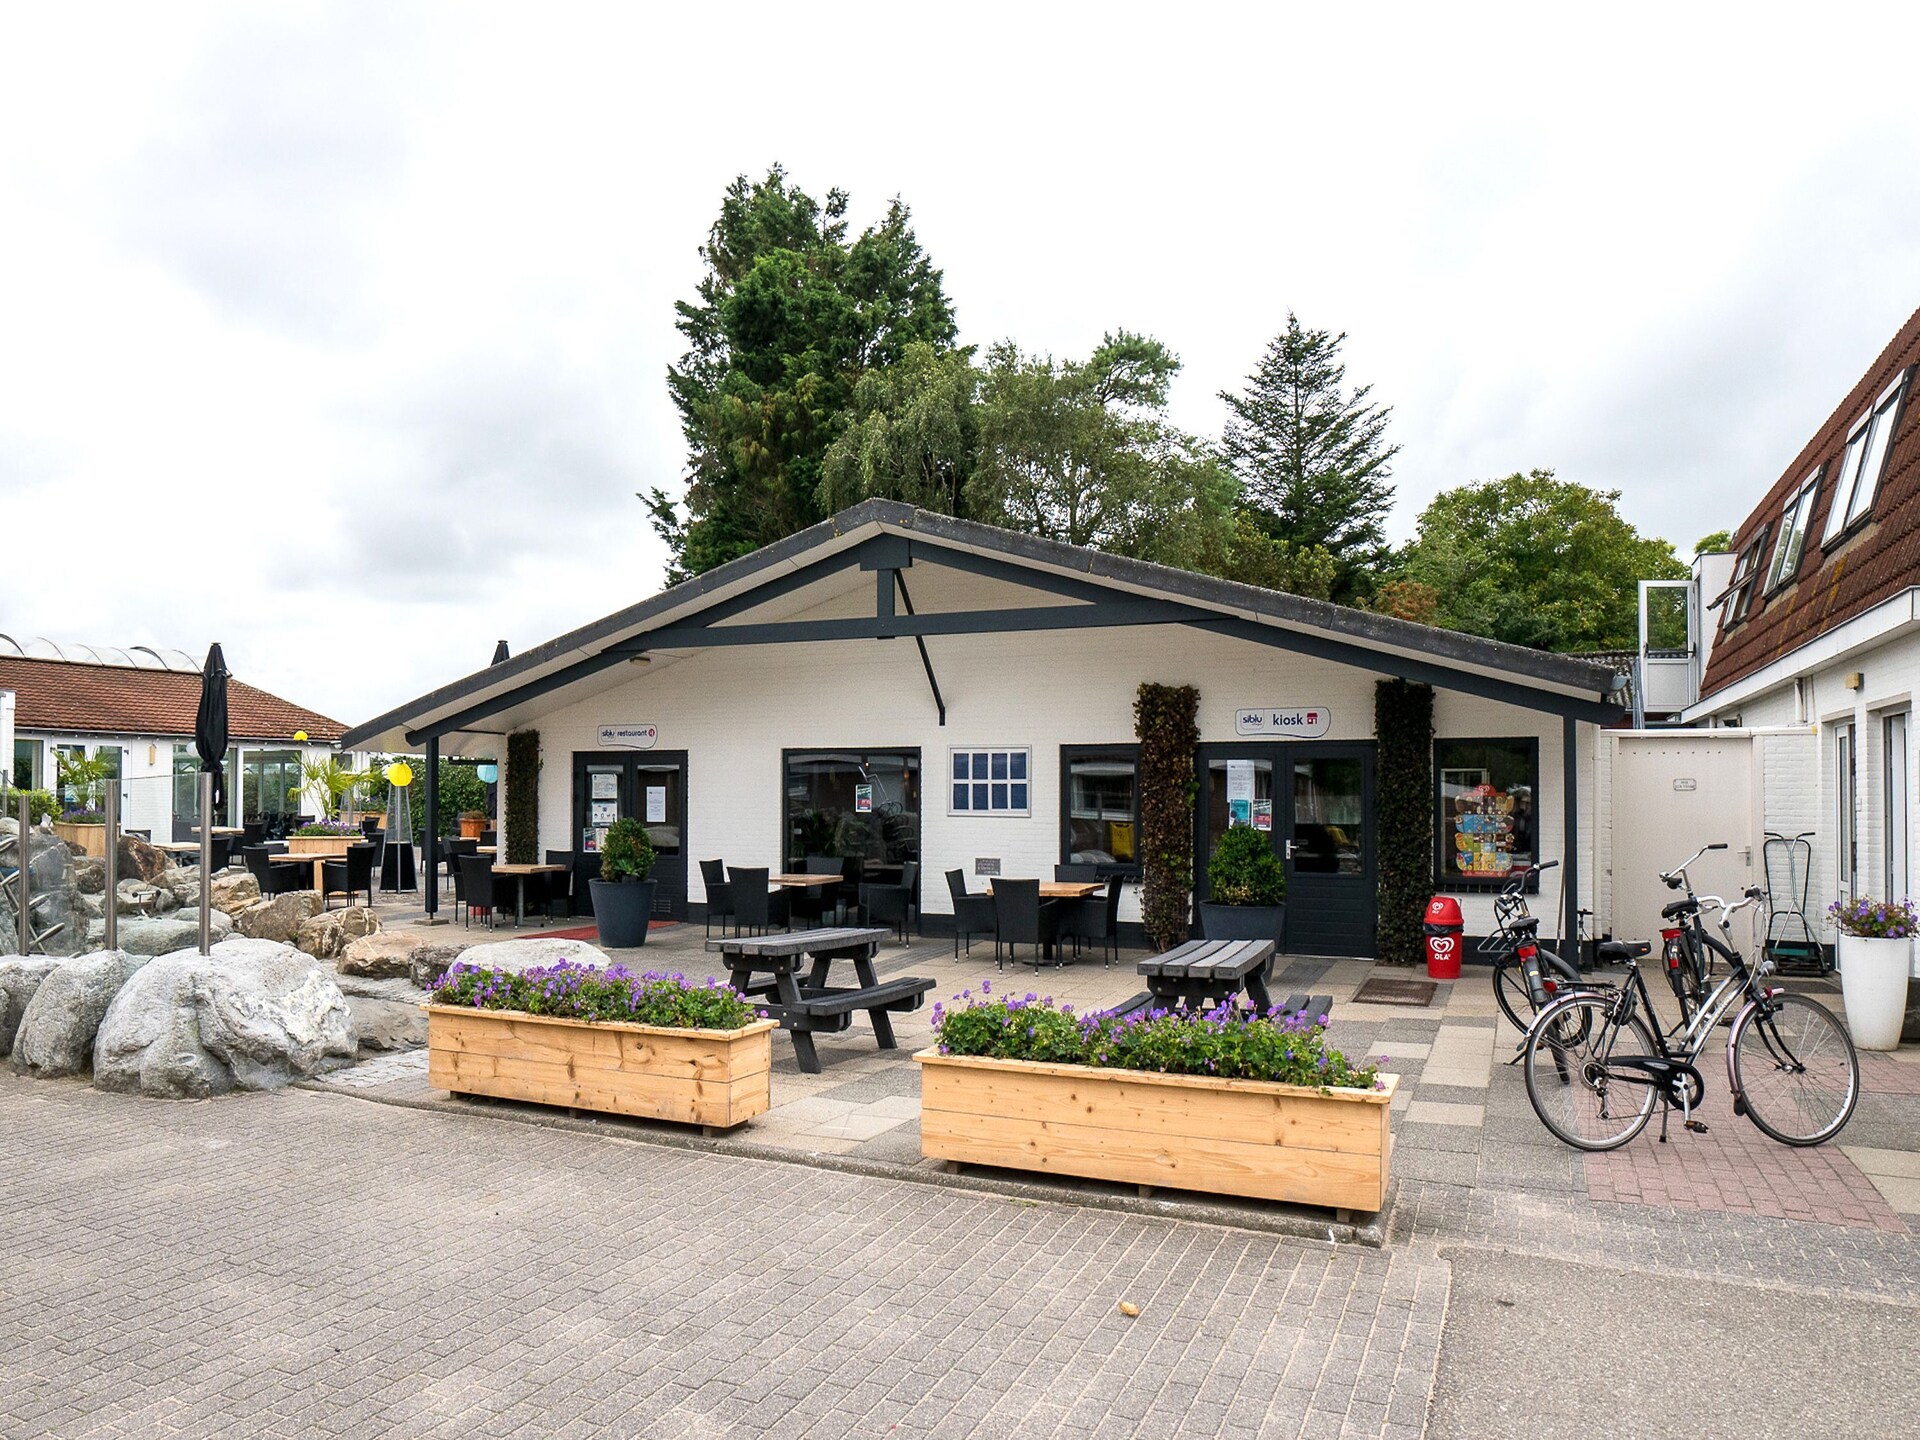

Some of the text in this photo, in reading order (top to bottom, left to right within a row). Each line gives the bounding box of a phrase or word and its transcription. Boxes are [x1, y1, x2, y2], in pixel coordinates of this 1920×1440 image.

[1242, 713, 1303, 726] siblu kiosk
[617, 729, 647, 737] restaurant
[1434, 953, 1450, 961] OLA
